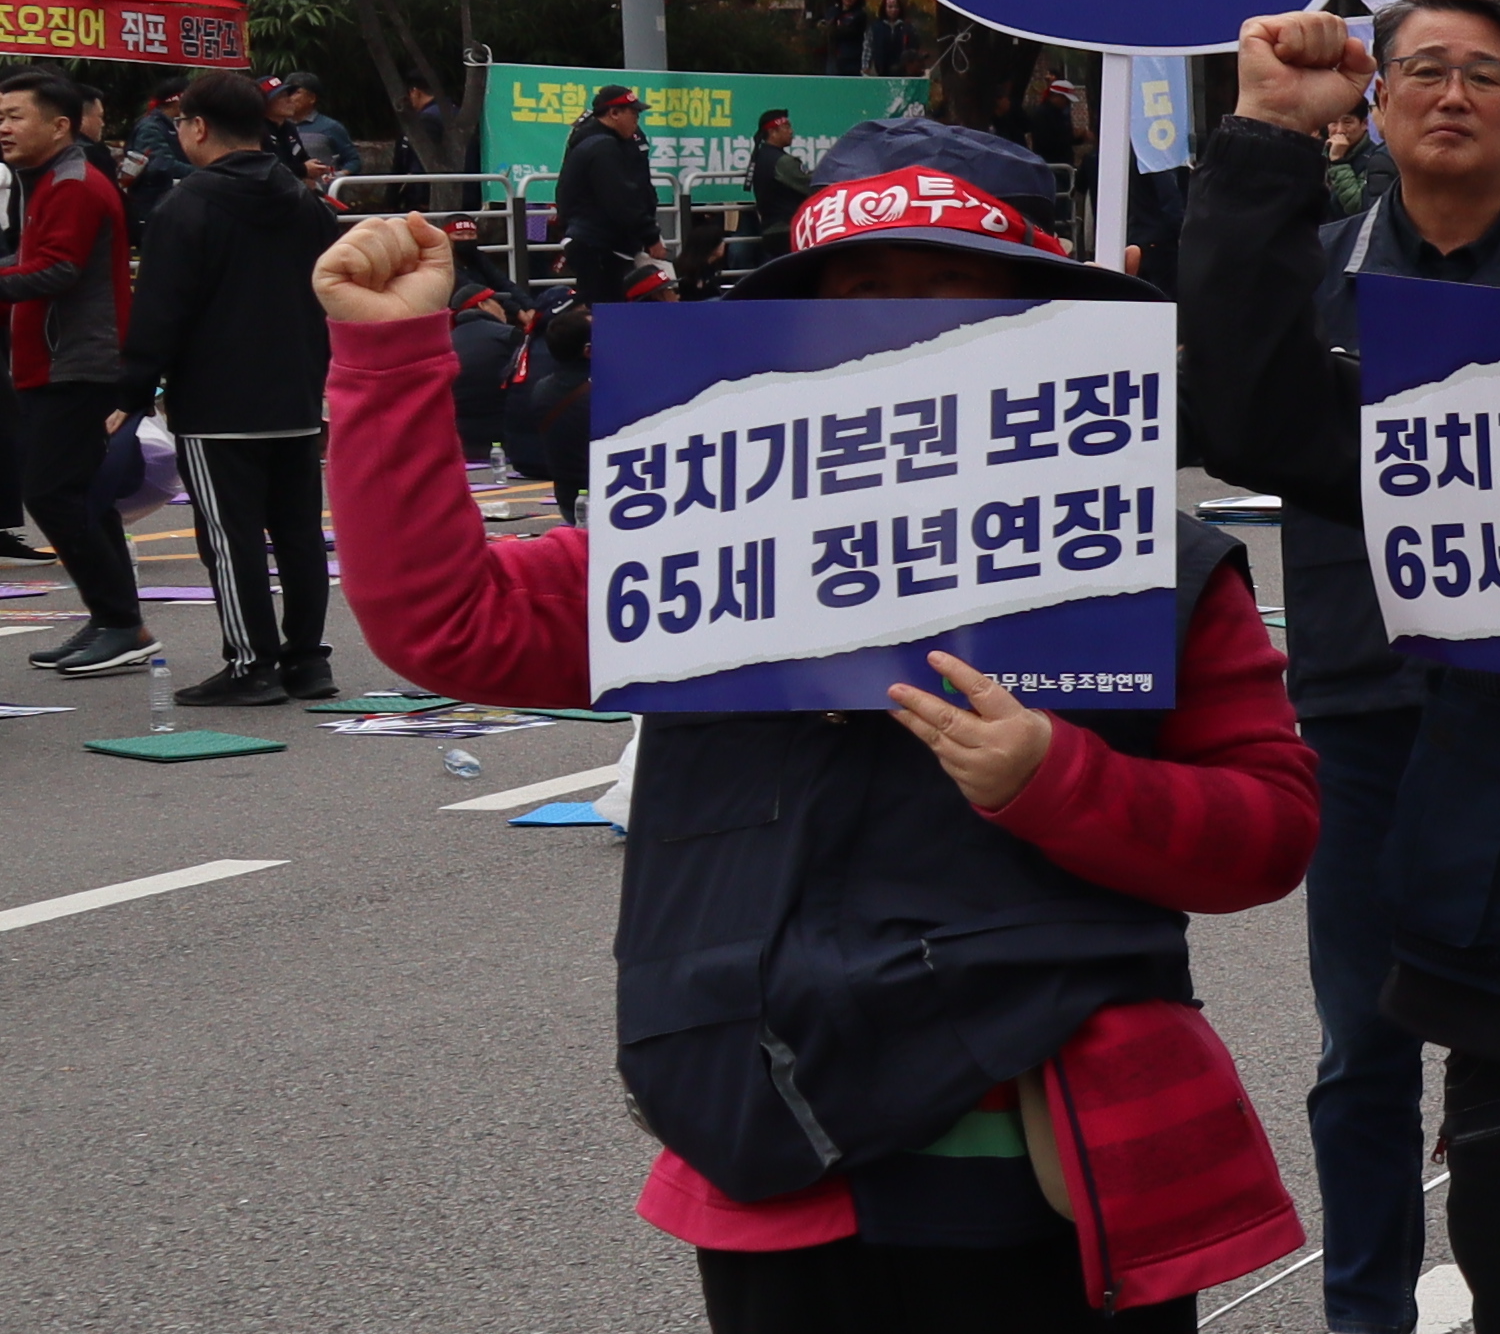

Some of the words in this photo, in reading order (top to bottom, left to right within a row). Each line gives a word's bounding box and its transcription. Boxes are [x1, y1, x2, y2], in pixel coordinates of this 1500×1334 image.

[121, 11, 169, 54] 쥐포
[512, 81, 587, 125] 노조할
[645, 85, 733, 128] 보장하고
[606, 394, 957, 530] 정치기본권
[987, 370, 1159, 465] 보장!
[607, 538, 775, 643] 65세
[812, 485, 1154, 608] 정년연장!
